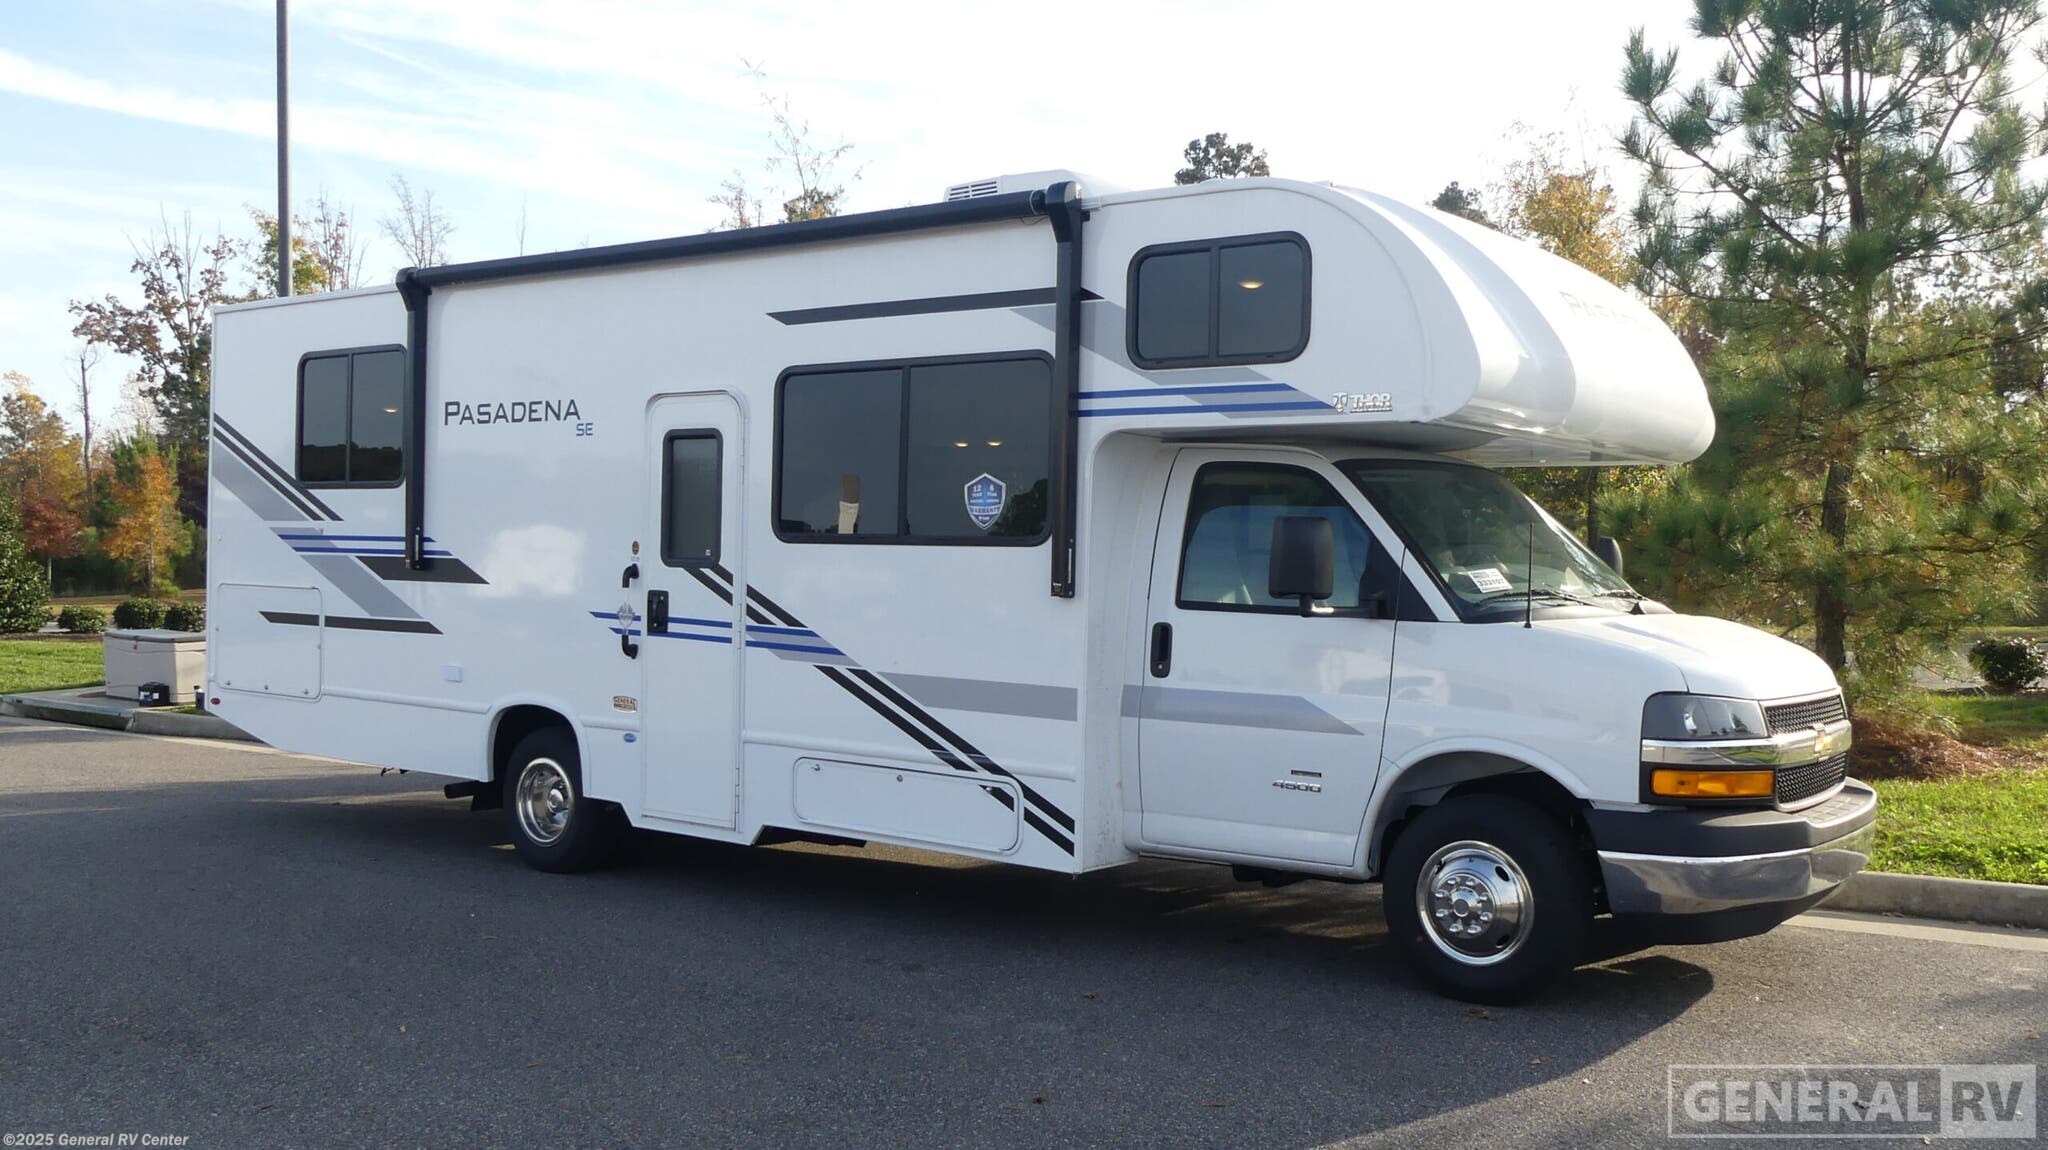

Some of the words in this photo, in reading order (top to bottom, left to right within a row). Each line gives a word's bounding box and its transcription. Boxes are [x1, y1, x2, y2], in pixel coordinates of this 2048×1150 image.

[1349, 393, 1392, 409] THOR
[576, 422, 594, 437] SE
[1271, 779, 1321, 792] 4500
